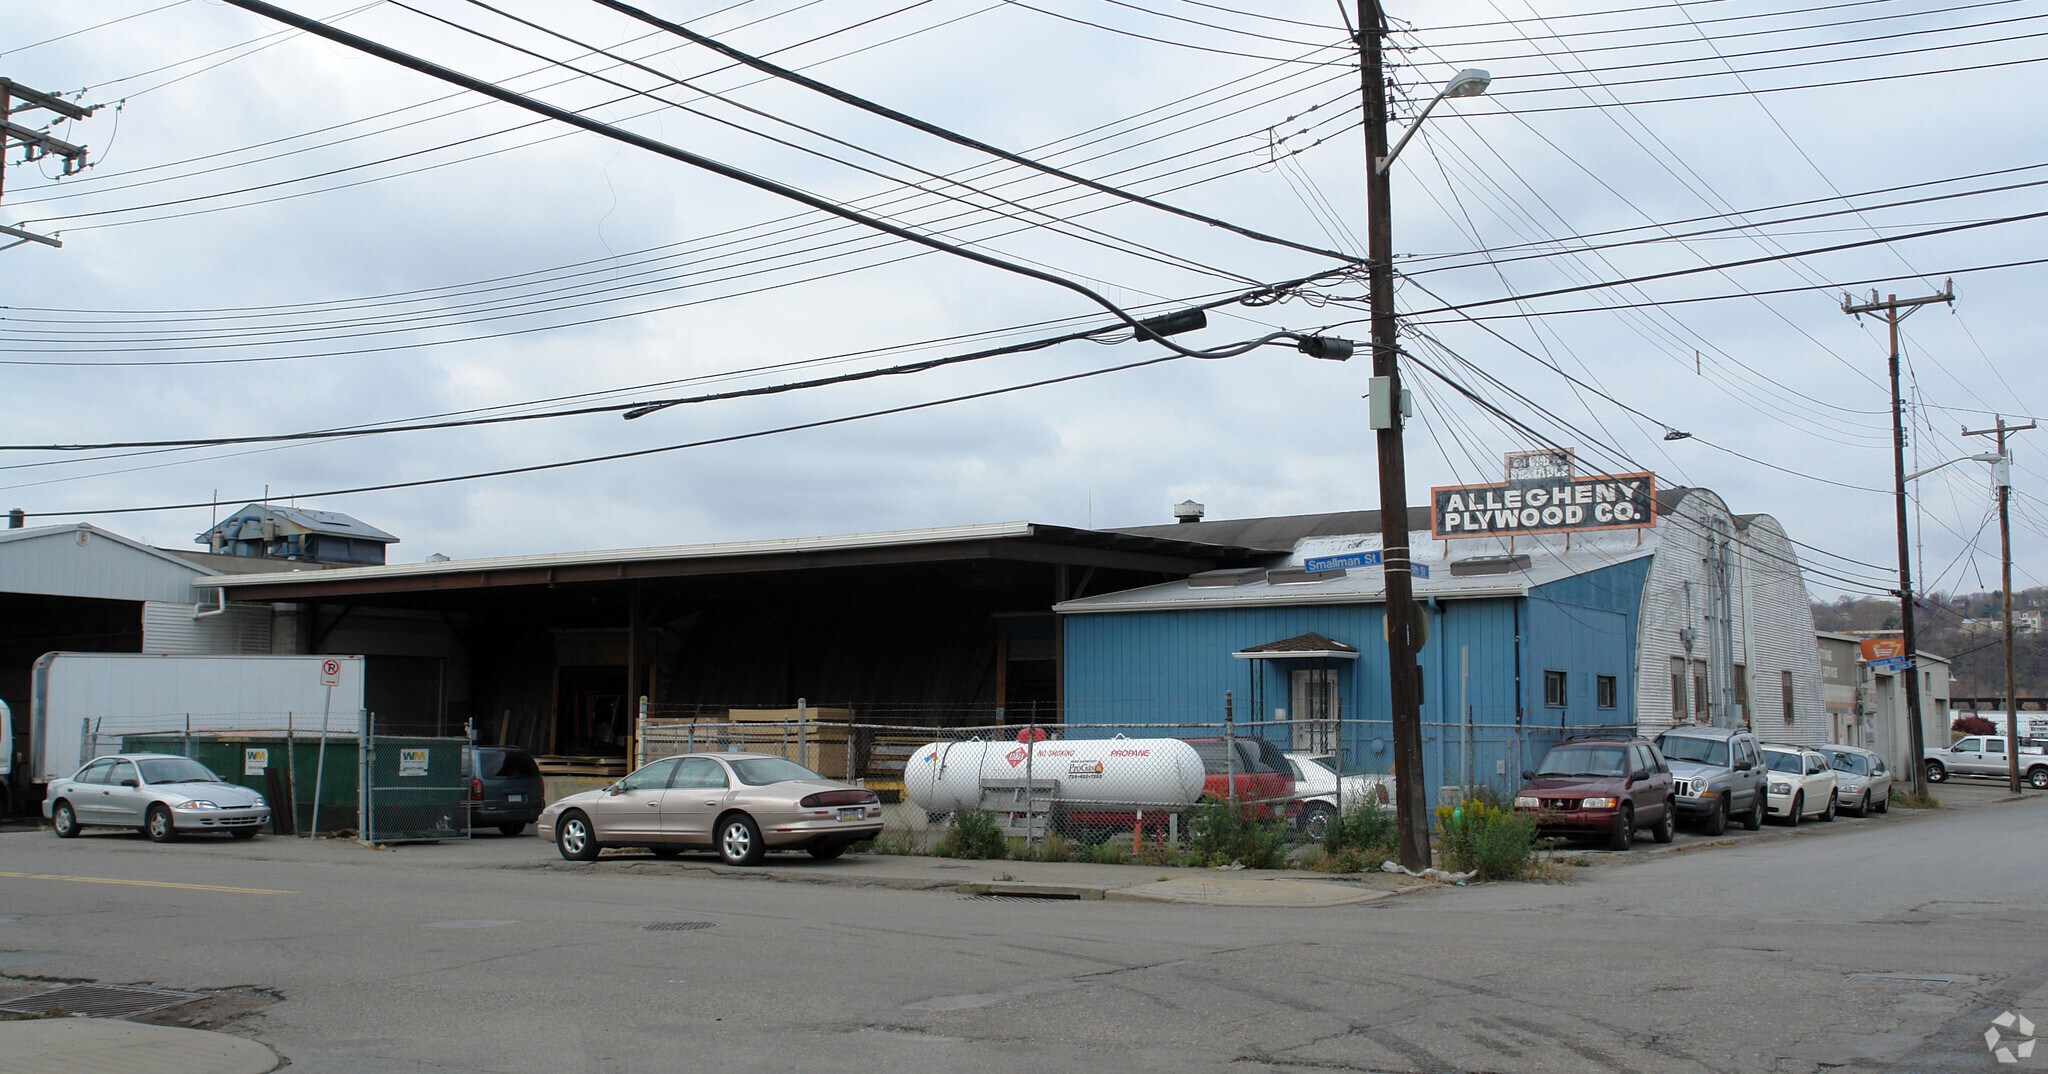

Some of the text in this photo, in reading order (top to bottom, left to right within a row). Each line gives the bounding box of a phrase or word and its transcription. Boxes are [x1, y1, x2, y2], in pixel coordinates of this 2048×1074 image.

[1447, 481, 1640, 512] ALLEGHENY
[1445, 502, 1641, 532] PLYWOOD CO.
[1308, 553, 1377, 571] Smallman St
[247, 751, 266, 760] WM
[402, 751, 426, 761] WM
[1048, 749, 1075, 757] SMOKING
[1110, 749, 1151, 757] PROPANE
